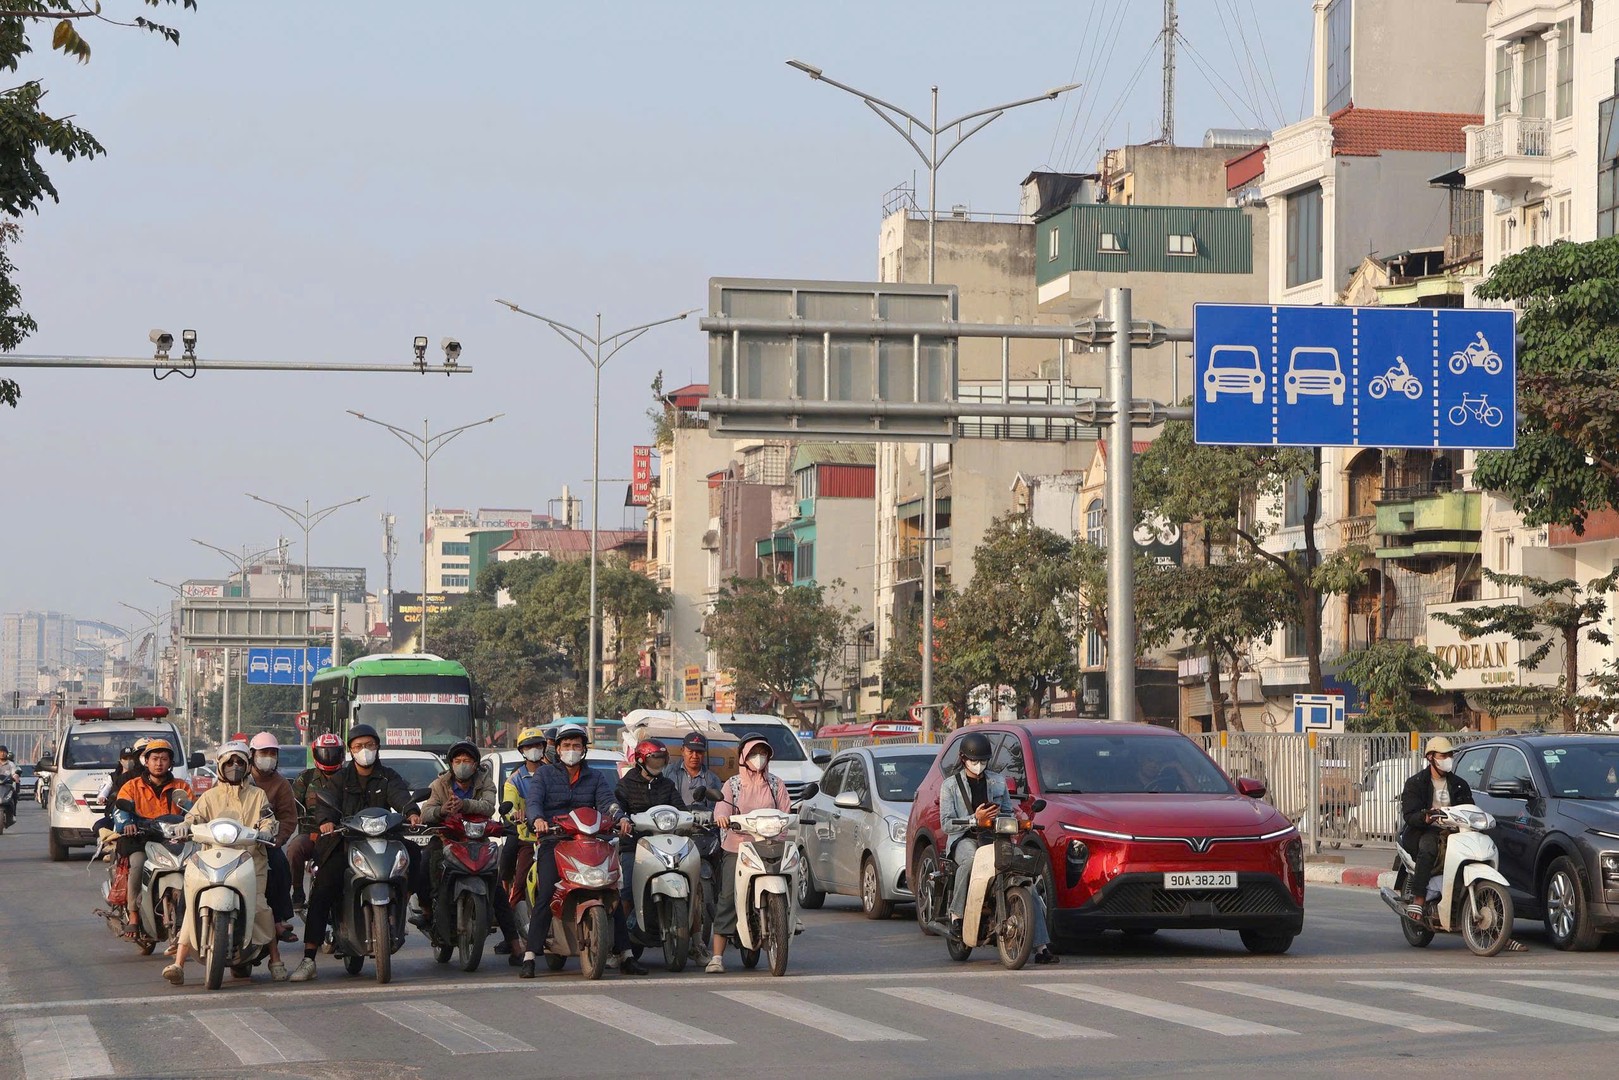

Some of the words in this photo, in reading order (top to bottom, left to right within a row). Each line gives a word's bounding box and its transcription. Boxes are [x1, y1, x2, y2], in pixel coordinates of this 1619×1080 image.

[481, 519, 529, 529] mobifone
[1480, 670, 1515, 684] CLINIC
[1171, 875, 1231, 886] 90A-382.20
